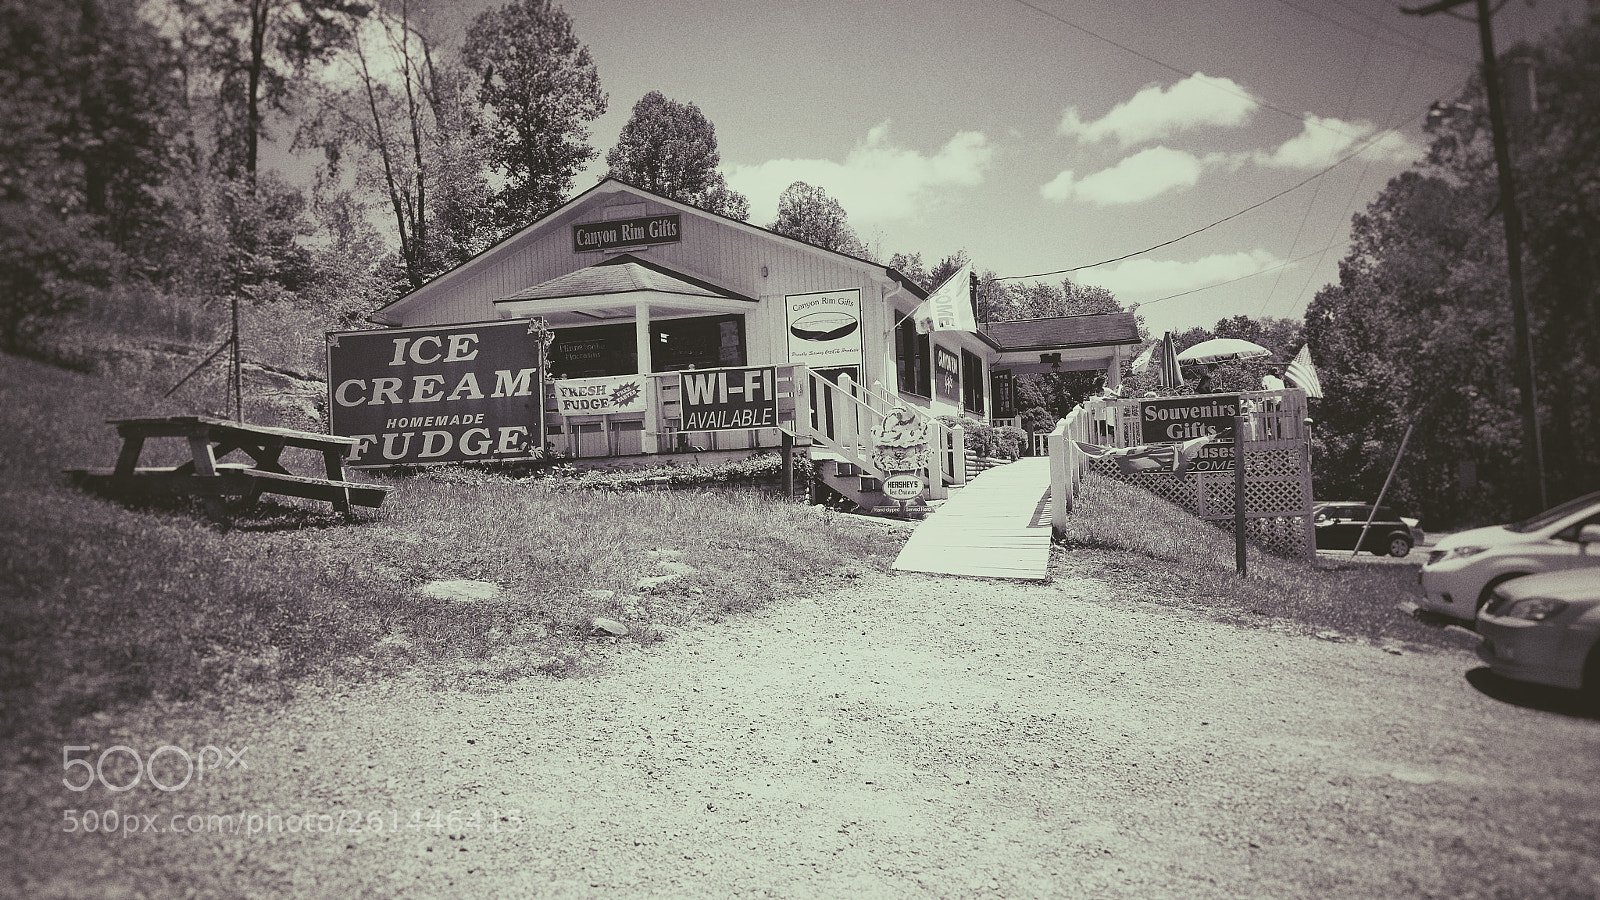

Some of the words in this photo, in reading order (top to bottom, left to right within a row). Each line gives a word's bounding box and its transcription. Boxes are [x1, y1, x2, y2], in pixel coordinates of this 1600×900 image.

[576, 228, 617, 248] Canyon
[621, 222, 645, 241] Rim
[648, 219, 677, 238] Gifts
[792, 299, 820, 312] Canyon
[821, 296, 836, 305] Rim
[837, 297, 854, 307] Gifts
[388, 333, 480, 366] ICE
[335, 368, 536, 407] CREAM
[560, 385, 607, 397] FRESH
[684, 370, 773, 405] WI-FI
[563, 398, 610, 410] FUDGE
[1145, 401, 1236, 421] Souvenirs
[386, 413, 485, 428] HOMEMADE
[686, 407, 773, 429] AVAILABLE
[1166, 421, 1217, 439] Gifts
[346, 427, 529, 461] FUDGE
[887, 481, 918, 489] HERSHEY'S
